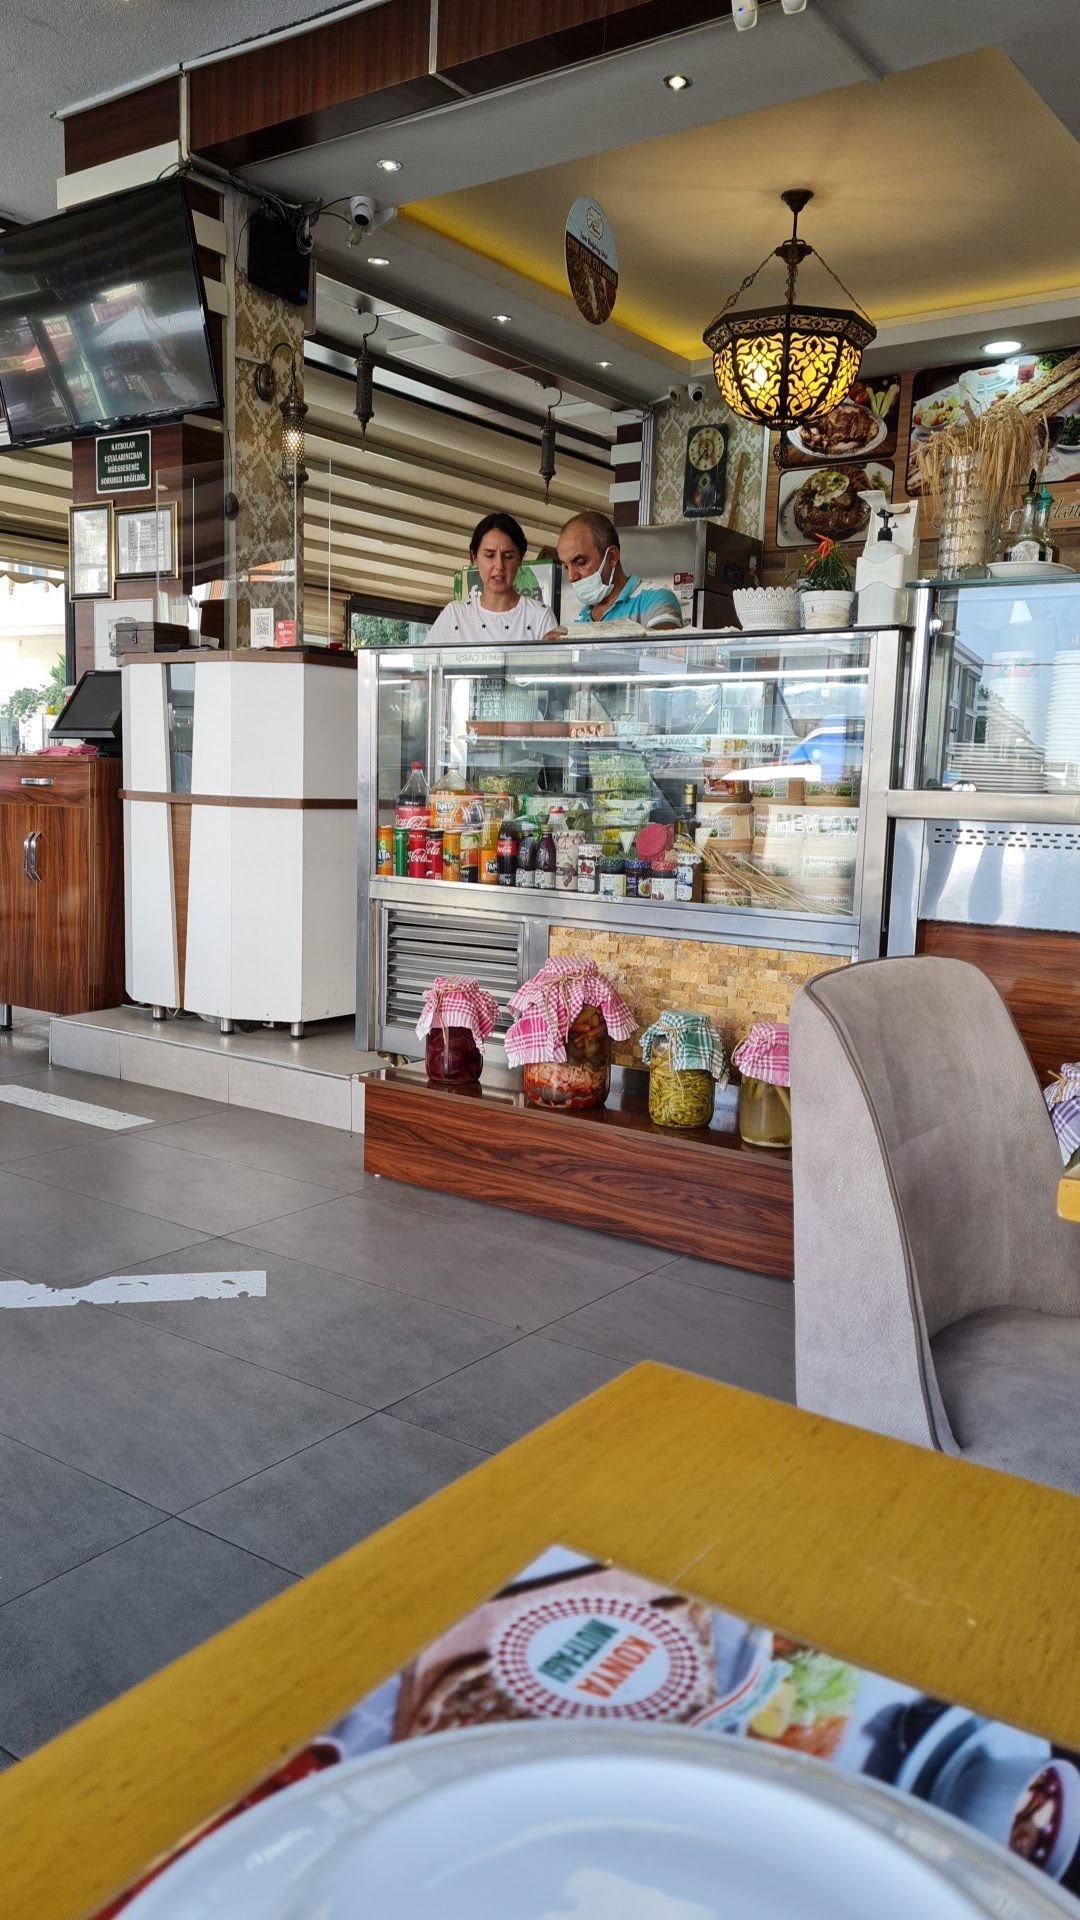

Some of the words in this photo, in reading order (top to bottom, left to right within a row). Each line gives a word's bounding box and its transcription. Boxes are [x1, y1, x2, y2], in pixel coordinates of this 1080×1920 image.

[110, 442, 136, 451] KAYBOLAN
[104, 451, 143, 464] EŞYALARINIZDAN
[100, 475, 123, 486] SORUMLU
[575, 1633, 657, 1699] KONYA
